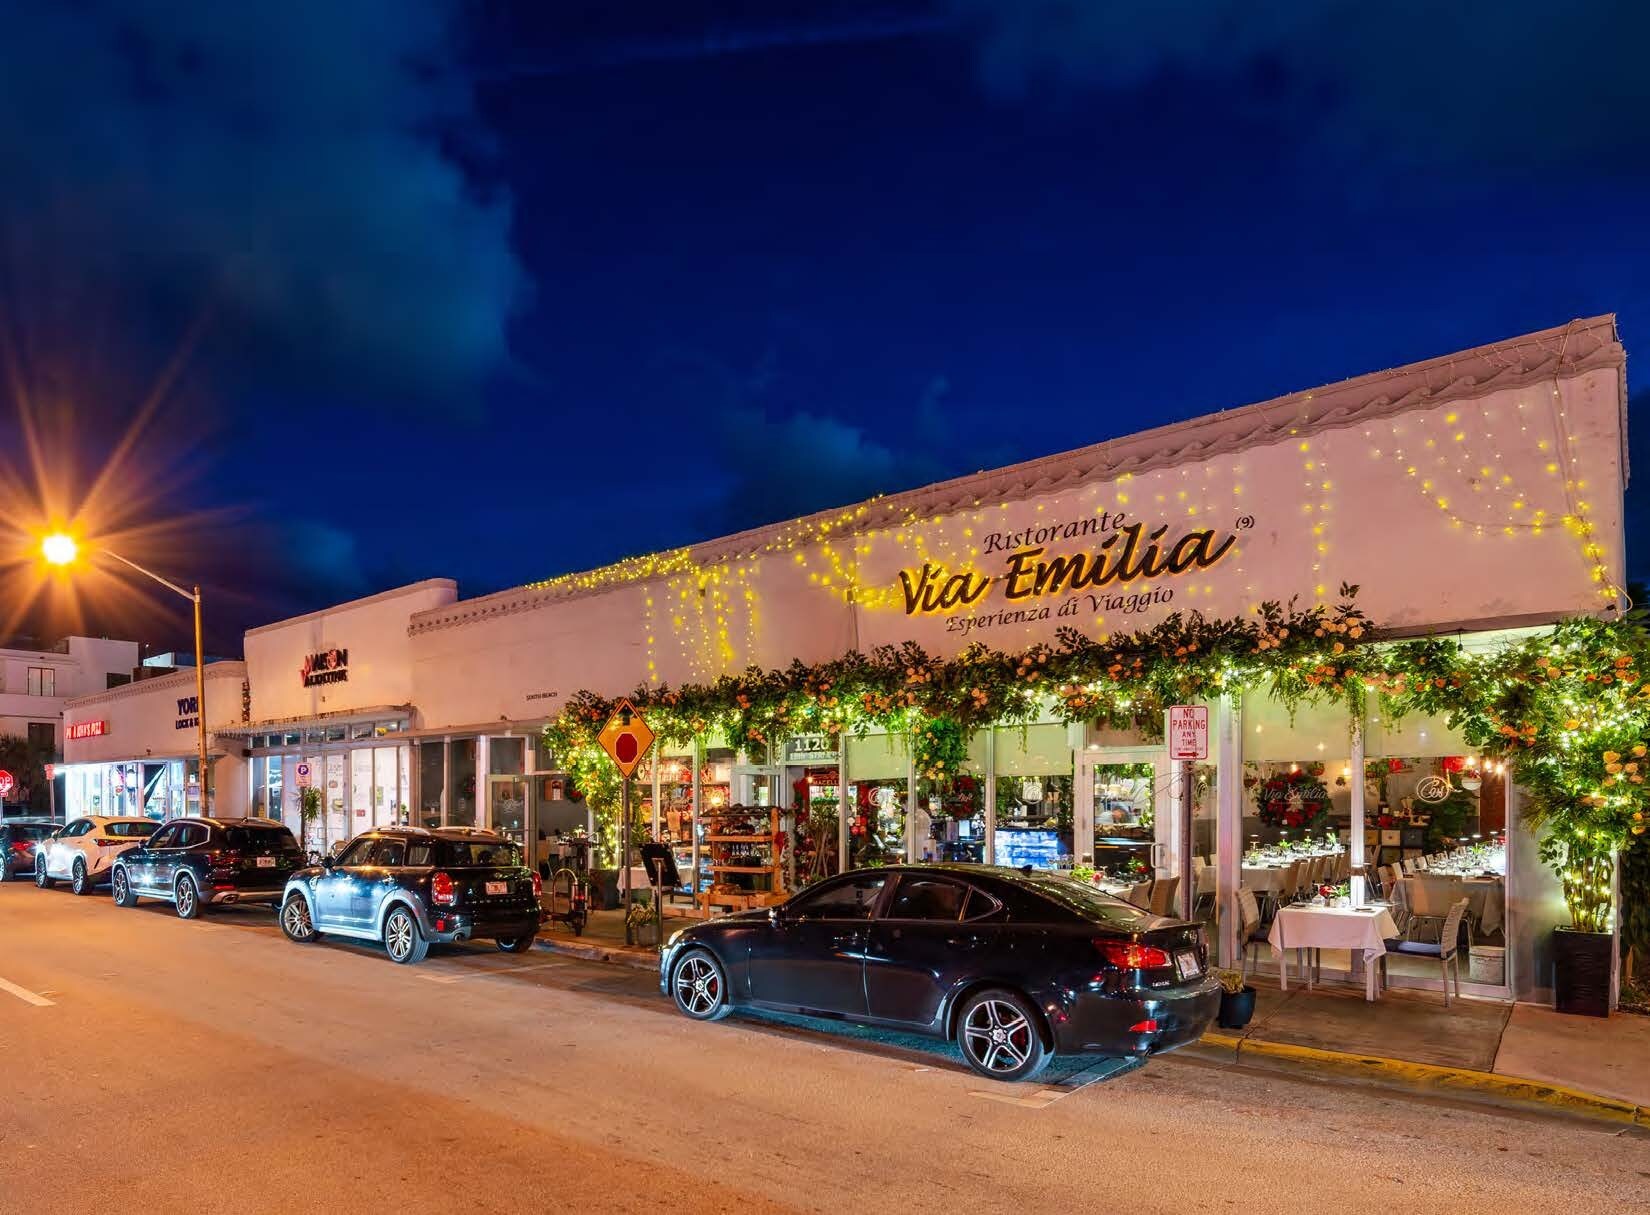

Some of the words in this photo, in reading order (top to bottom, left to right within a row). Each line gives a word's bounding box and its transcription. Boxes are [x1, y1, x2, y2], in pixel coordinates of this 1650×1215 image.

[984, 511, 1126, 555] Ristorante
[898, 563, 990, 615] Via
[1004, 522, 1237, 599] Emilia
[1235, 515, 1255, 530] (9)
[945, 606, 1050, 637] Esperienza
[1057, 597, 1079, 617] di
[1082, 586, 1174, 615] Viaggio
[1183, 708, 1195, 719] NO
[1172, 719, 1206, 730] PARKING
[795, 738, 830, 751] 1120
[1182, 738, 1196, 746] TIME
